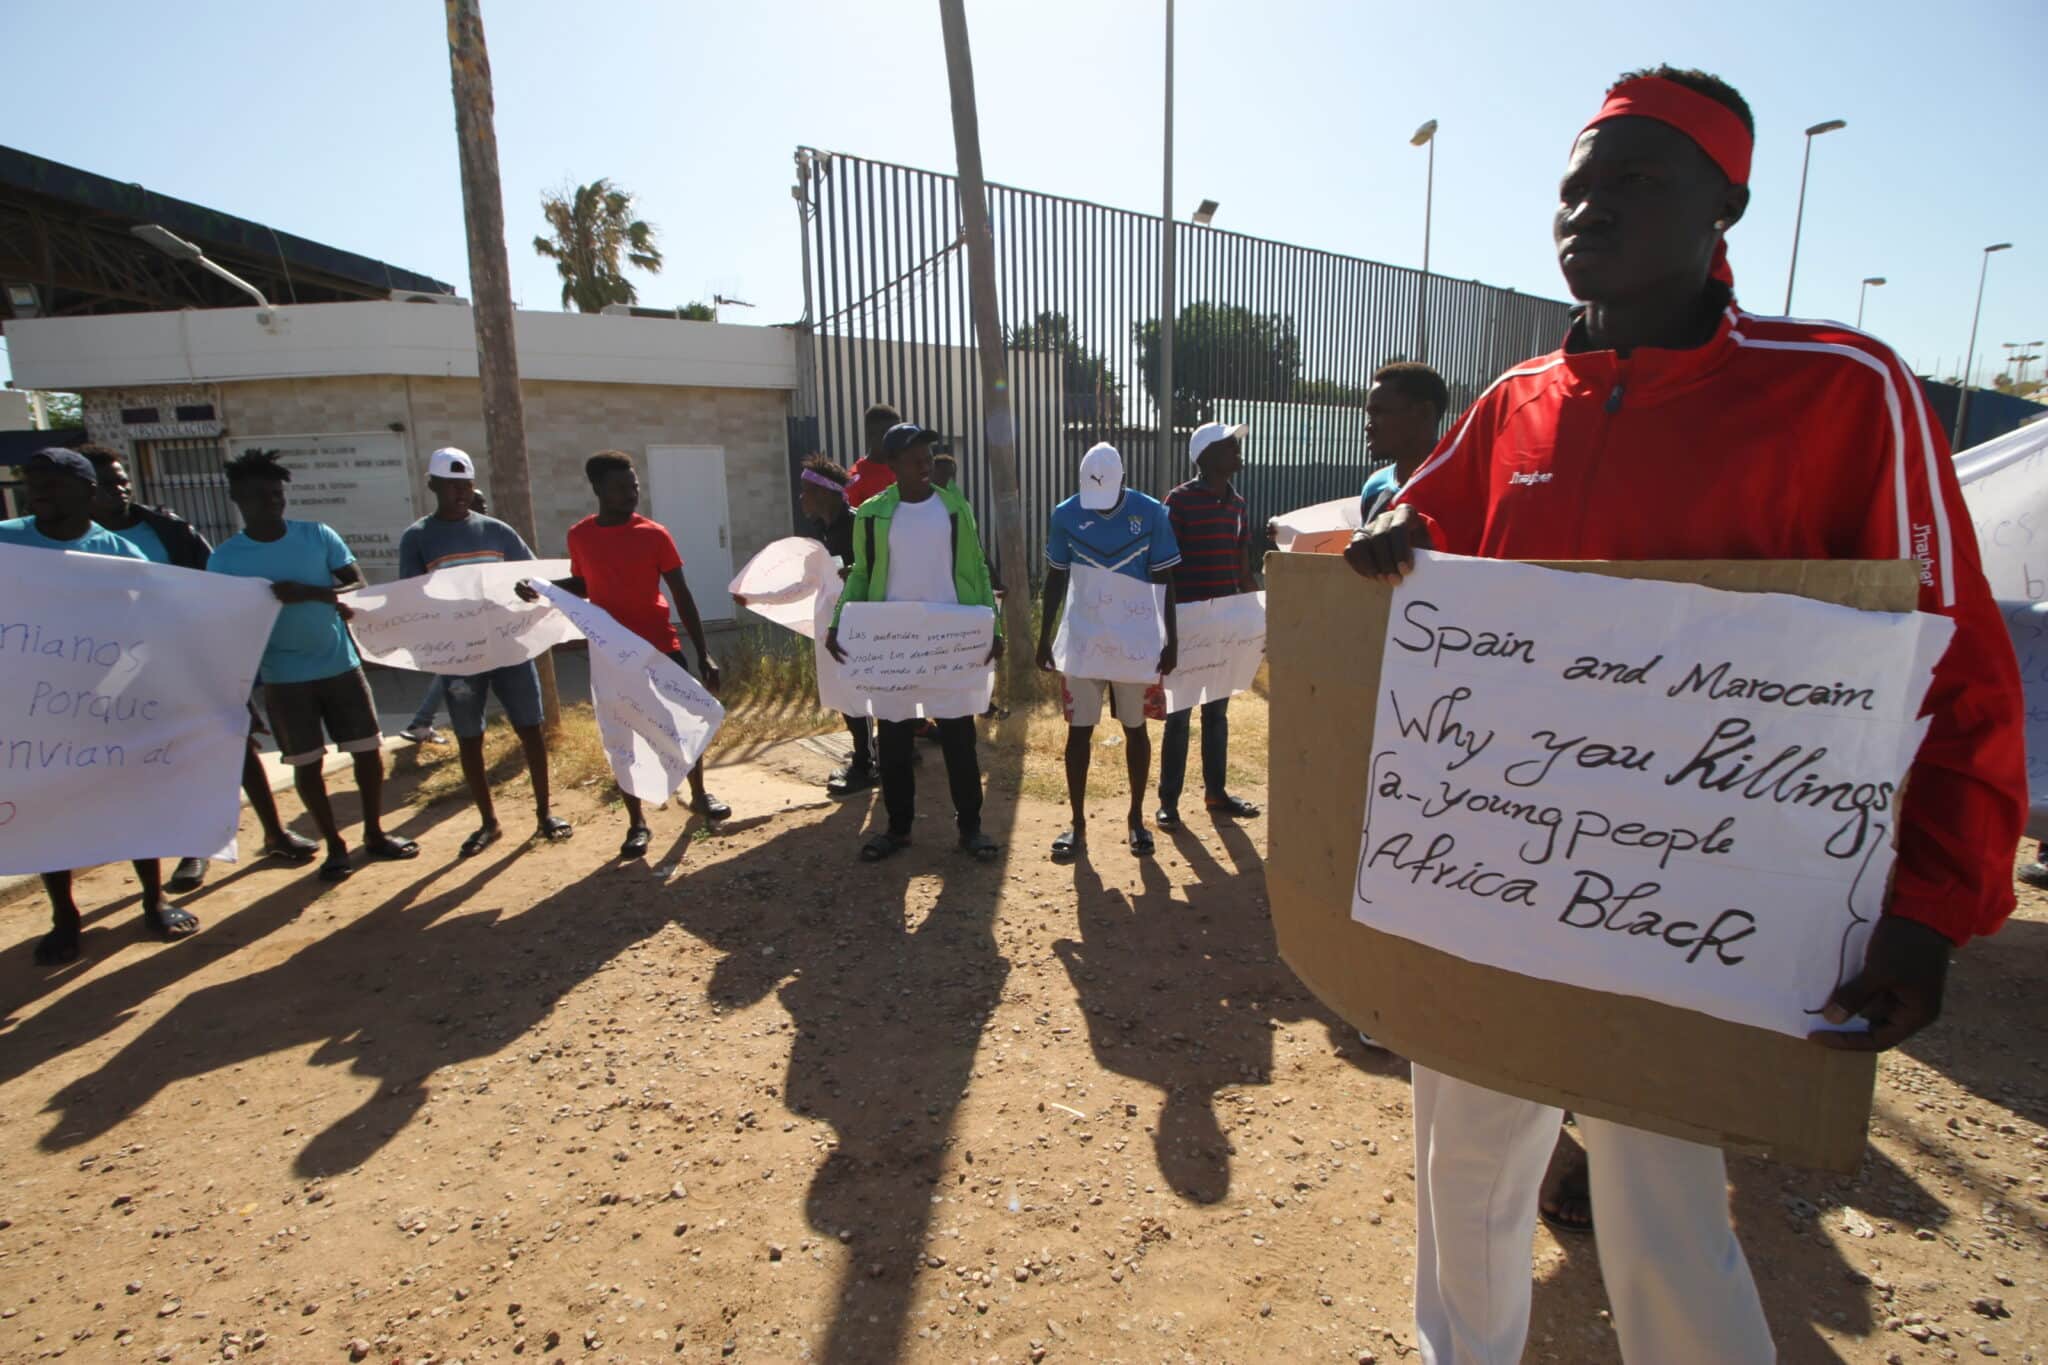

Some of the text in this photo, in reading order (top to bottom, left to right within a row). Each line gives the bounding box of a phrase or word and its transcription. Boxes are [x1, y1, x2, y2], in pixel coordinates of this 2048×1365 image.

[1393, 601, 1535, 668] Spain
[1563, 655, 1664, 684] and
[0, 739, 124, 769] nvian
[1391, 687, 1495, 771] Why
[1504, 730, 1655, 787] you
[1368, 833, 1538, 906] Africa
